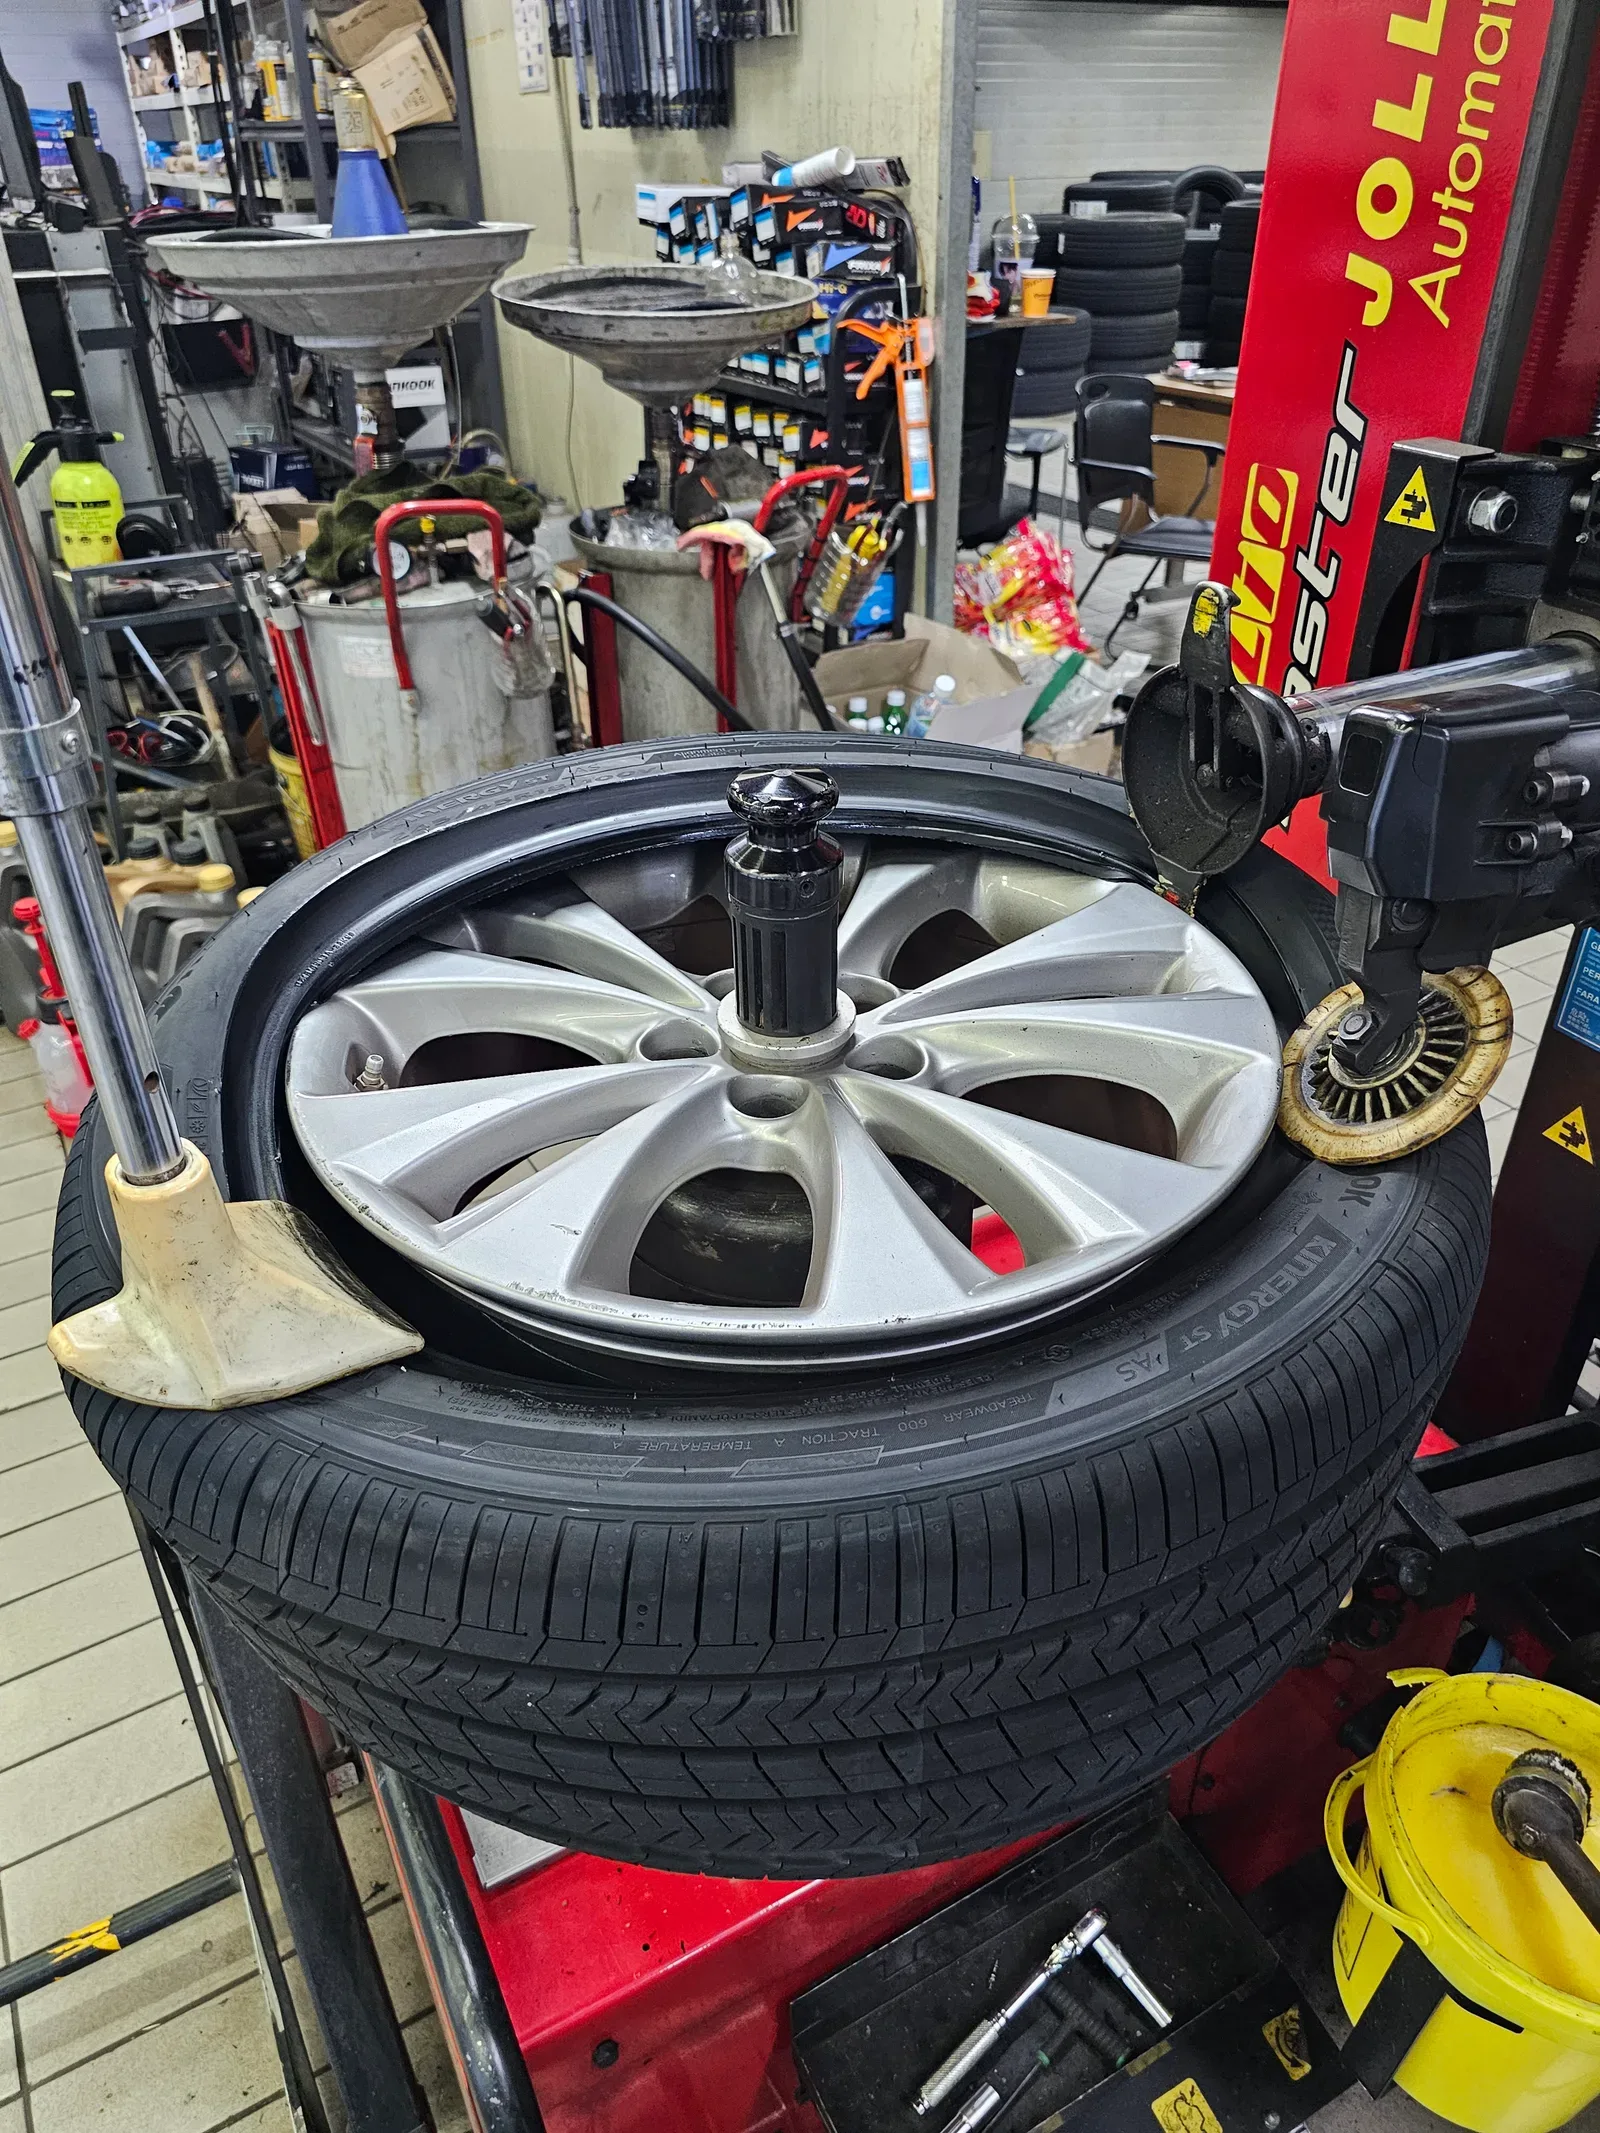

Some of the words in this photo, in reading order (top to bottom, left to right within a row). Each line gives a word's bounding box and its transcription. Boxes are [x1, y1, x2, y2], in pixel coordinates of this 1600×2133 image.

[1345, 0, 1447, 326] JOLL
[391, 379, 436, 392] NKOOK
[1283, 338, 1369, 698] aster
[1337, 1176, 1382, 1207] OK
[1218, 1234, 1337, 1339] KINERGY
[1180, 1325, 1212, 1351] ST
[1116, 1351, 1153, 1382] AS
[943, 1391, 1037, 1423] TREADWEAR
[801, 1426, 880, 1446] TRACTION
[897, 1417, 928, 1433] 600
[612, 1441, 624, 1450] A
[638, 1440, 752, 1451] TEMPERATURE
[774, 1437, 786, 1447] A
